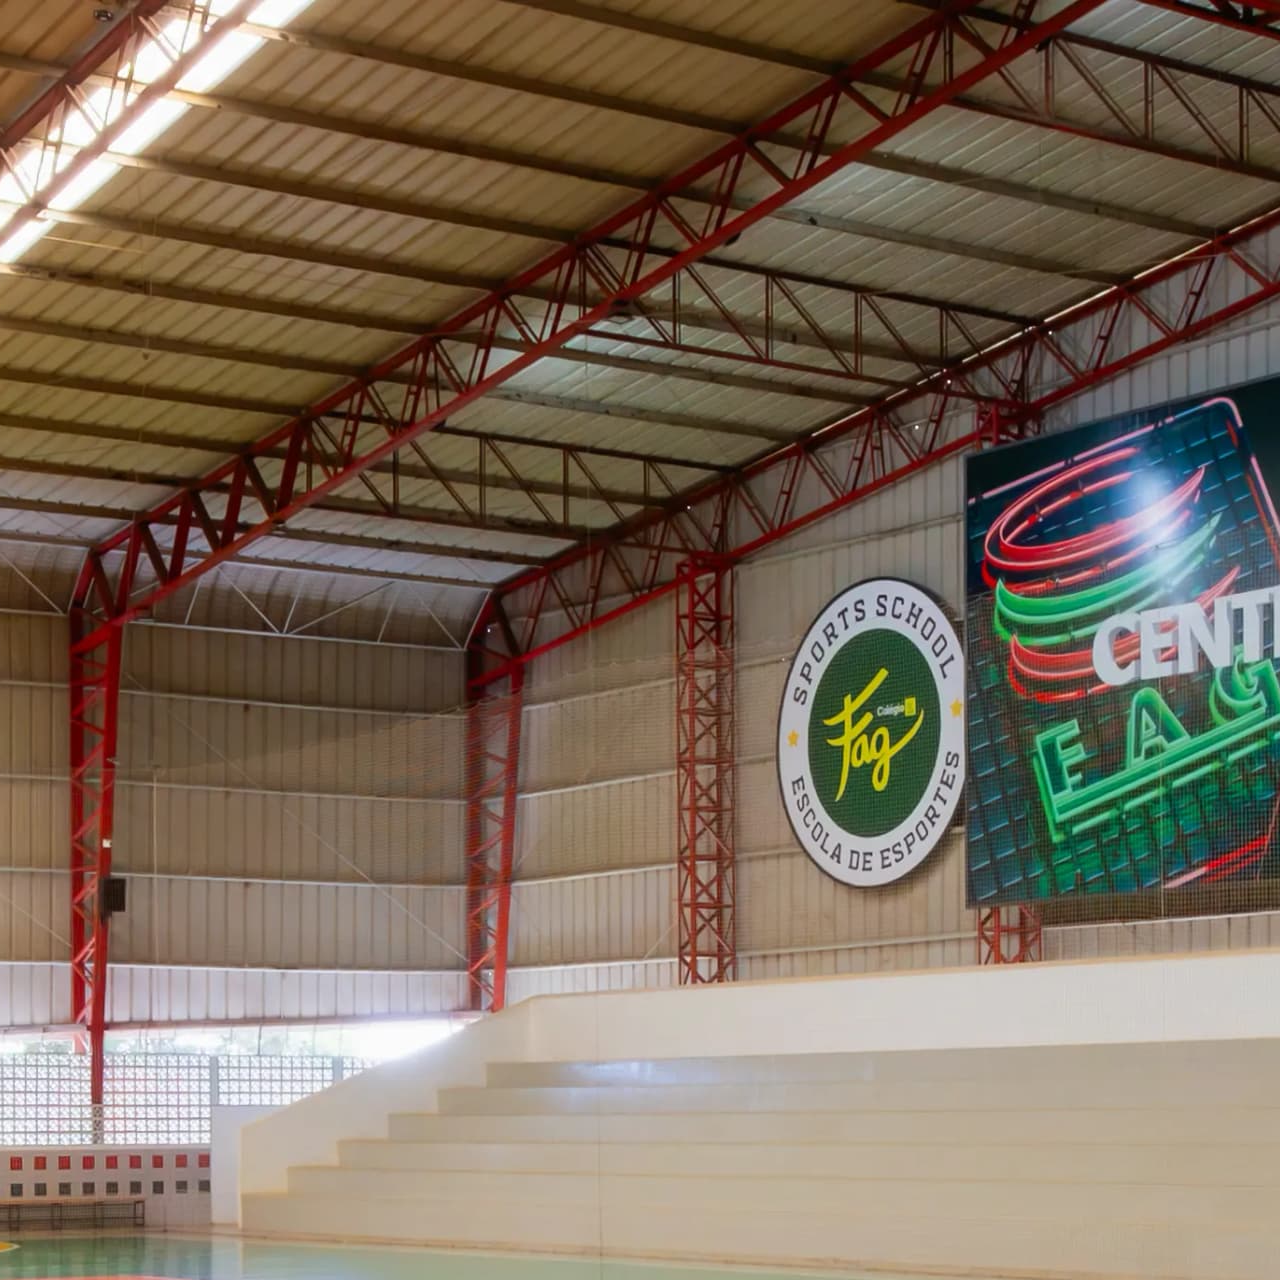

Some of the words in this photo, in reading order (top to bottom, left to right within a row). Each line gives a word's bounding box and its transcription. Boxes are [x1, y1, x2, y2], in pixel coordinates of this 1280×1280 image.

[793, 598, 867, 706] SPORTS
[875, 594, 956, 680] SCHOOL
[822, 667, 925, 803] Fag
[791, 775, 842, 866] ESCOLA
[848, 849, 873, 872] DE
[880, 750, 960, 871] ESPORTES
